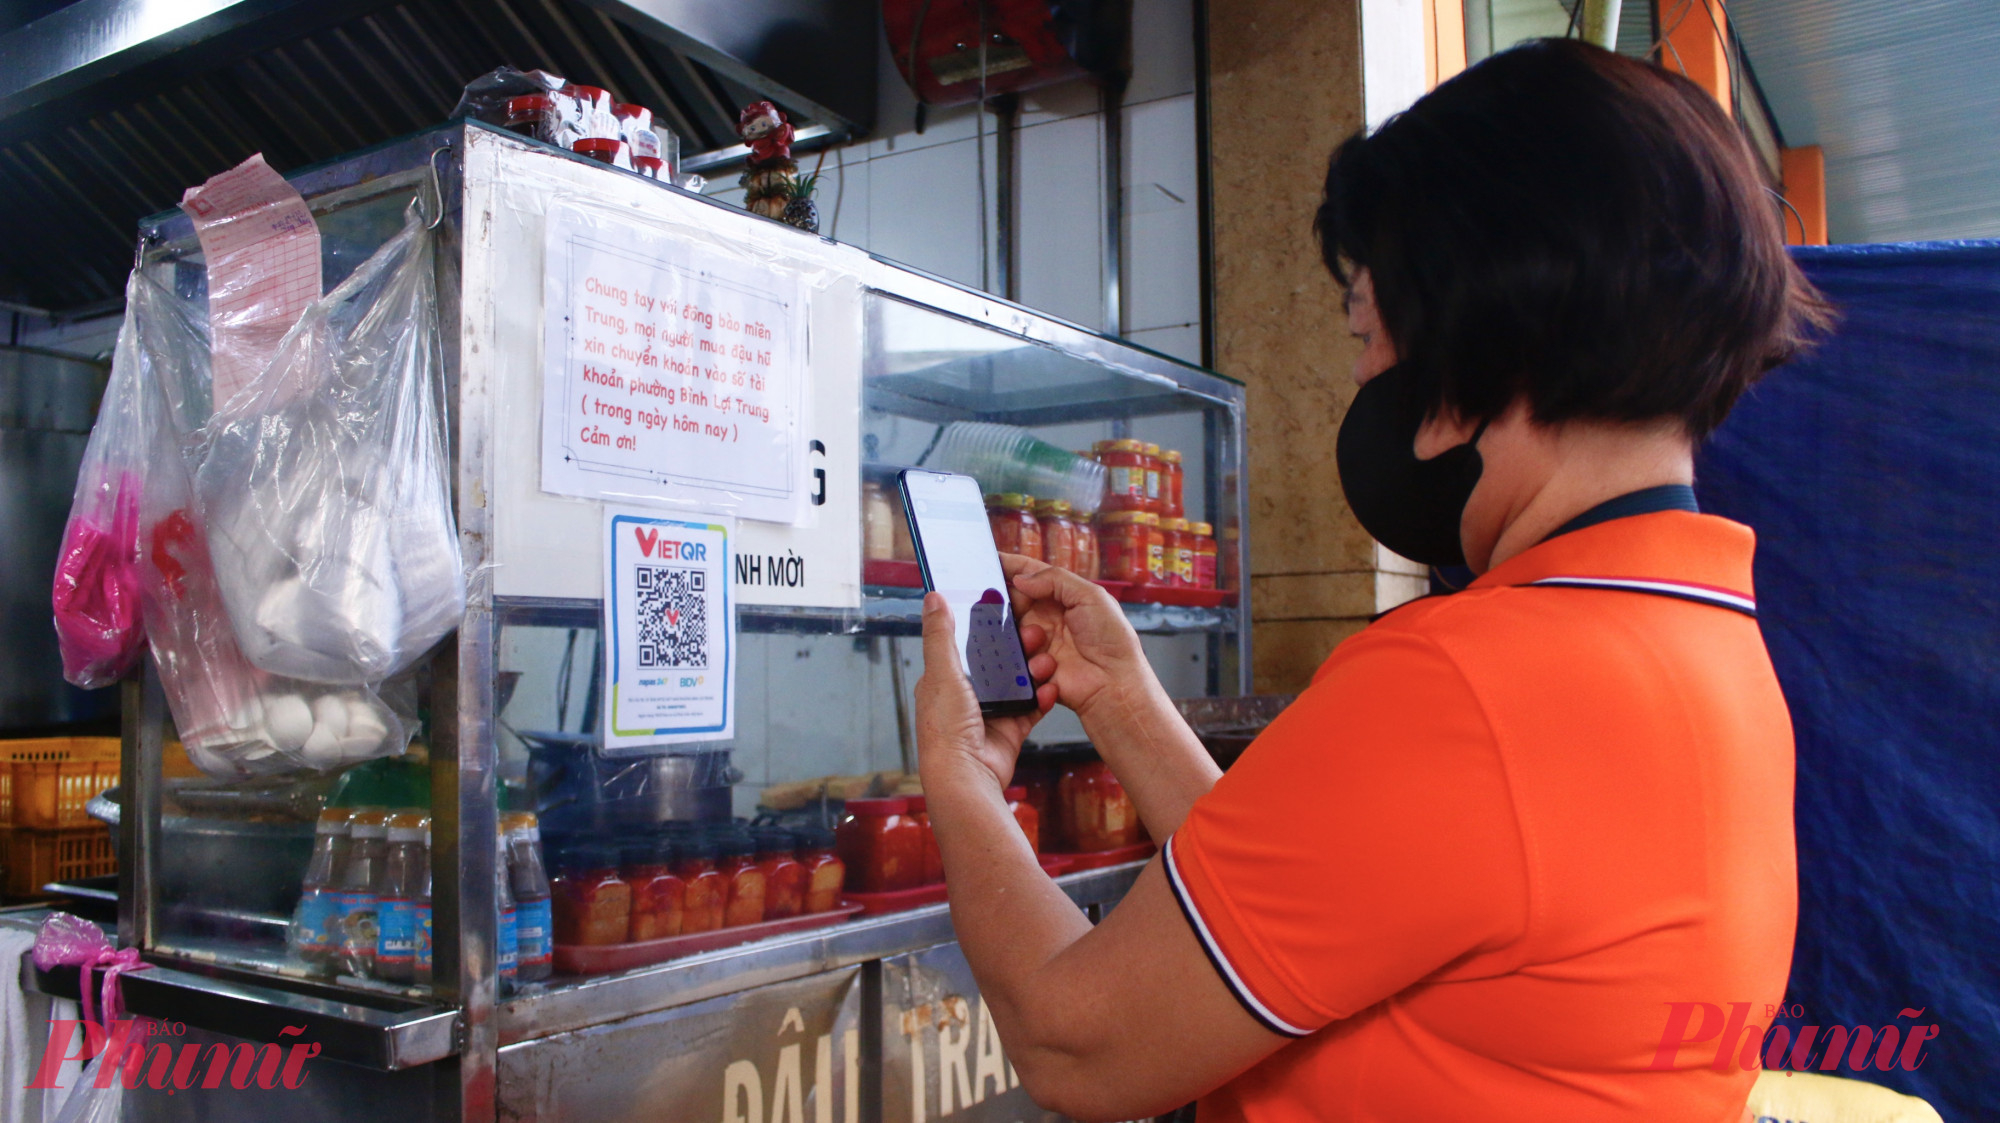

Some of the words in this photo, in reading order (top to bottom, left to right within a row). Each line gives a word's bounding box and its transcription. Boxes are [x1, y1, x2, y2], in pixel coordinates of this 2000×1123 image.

[585, 277, 628, 307] Chung
[634, 289, 655, 312] tay
[660, 298, 677, 316] với
[718, 312, 740, 332] bào
[745, 321, 771, 340] miền
[585, 306, 628, 335] Trung,
[634, 321, 656, 342] mọi
[661, 328, 694, 348] người
[700, 339, 726, 355] mua
[731, 344, 752, 365] đậu
[757, 351, 771, 366] hũ
[584, 337, 605, 355] xin
[611, 343, 658, 367] chuyển
[705, 366, 727, 383] vào
[732, 371, 746, 387] số
[750, 373, 765, 391] tài
[583, 364, 624, 388] khoản
[630, 378, 675, 404] phường
[680, 387, 708, 407] Bình
[714, 394, 731, 415] Lợi
[736, 399, 769, 423] Trung
[595, 399, 632, 425] trong
[638, 407, 668, 431] ngày
[674, 414, 699, 433] hôm
[705, 423, 728, 441] nay
[580, 425, 610, 446] Cảm
[616, 435, 636, 451] ơn!
[634, 526, 707, 562] VIETQR
[768, 548, 804, 588] MỜI
[900, 993, 1020, 1123] TRA
